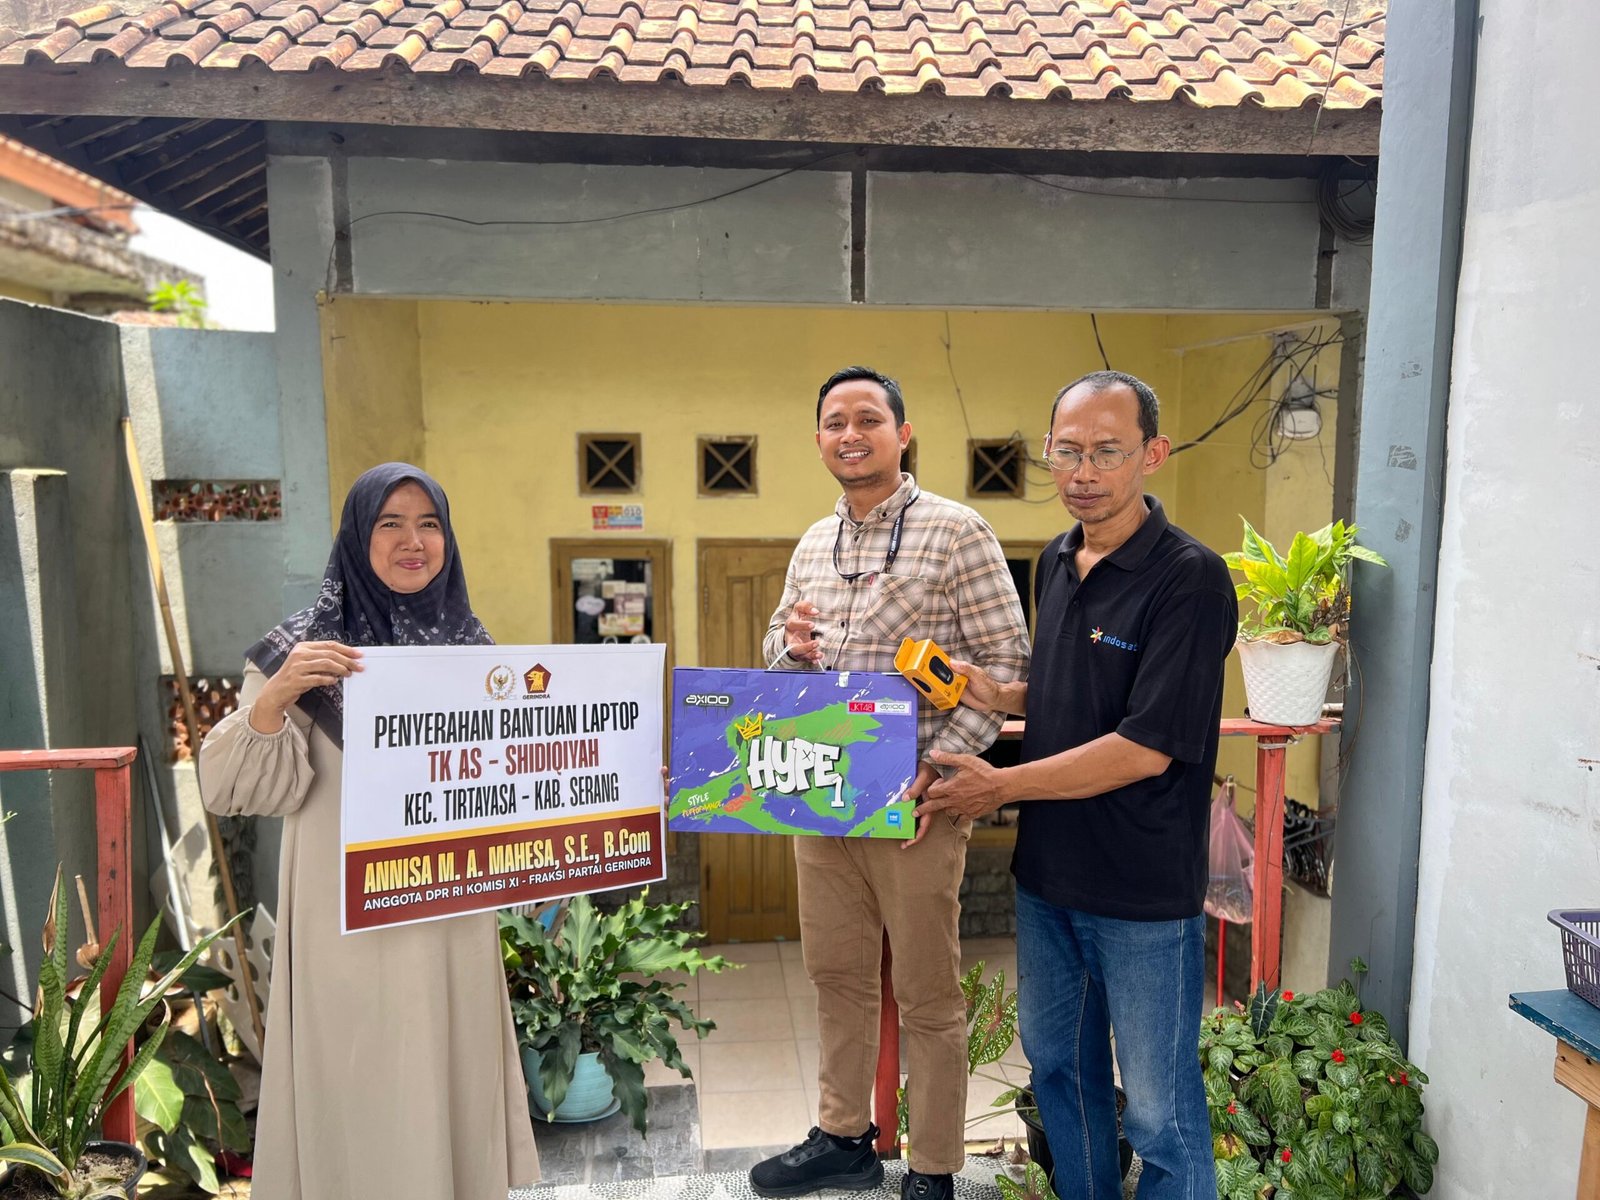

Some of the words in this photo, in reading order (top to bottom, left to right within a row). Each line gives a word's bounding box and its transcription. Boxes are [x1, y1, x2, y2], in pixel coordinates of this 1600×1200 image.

[374, 709, 494, 748] PENYERAHAN
[500, 704, 577, 739] BANTUAN
[582, 701, 639, 733] LAPTOP
[850, 703, 873, 712] JKT48
[428, 750, 452, 783] TK
[458, 747, 482, 780] AS
[505, 738, 599, 776] SHIDIQIYAH
[747, 735, 841, 795] HYPE
[404, 791, 437, 826] KEC.
[443, 783, 517, 821] TIRTAYASA
[535, 778, 565, 811] KAB.
[570, 772, 619, 807] SERANG
[687, 792, 710, 806] STYLE
[363, 855, 433, 894] ANNISA
[438, 851, 461, 883] M.
[466, 848, 484, 879] A.
[488, 838, 560, 875] MAHESA,
[564, 834, 600, 864] S.E.,
[603, 828, 651, 858] B.Com
[363, 891, 423, 911] ANGGOTA
[425, 888, 450, 901] DPR
[452, 886, 463, 897] RI
[466, 879, 506, 895] KOMISI
[508, 877, 519, 889] XI
[528, 869, 566, 885] FRAKSI
[568, 864, 602, 879] PARTAI
[604, 856, 652, 873] GERINDRA
